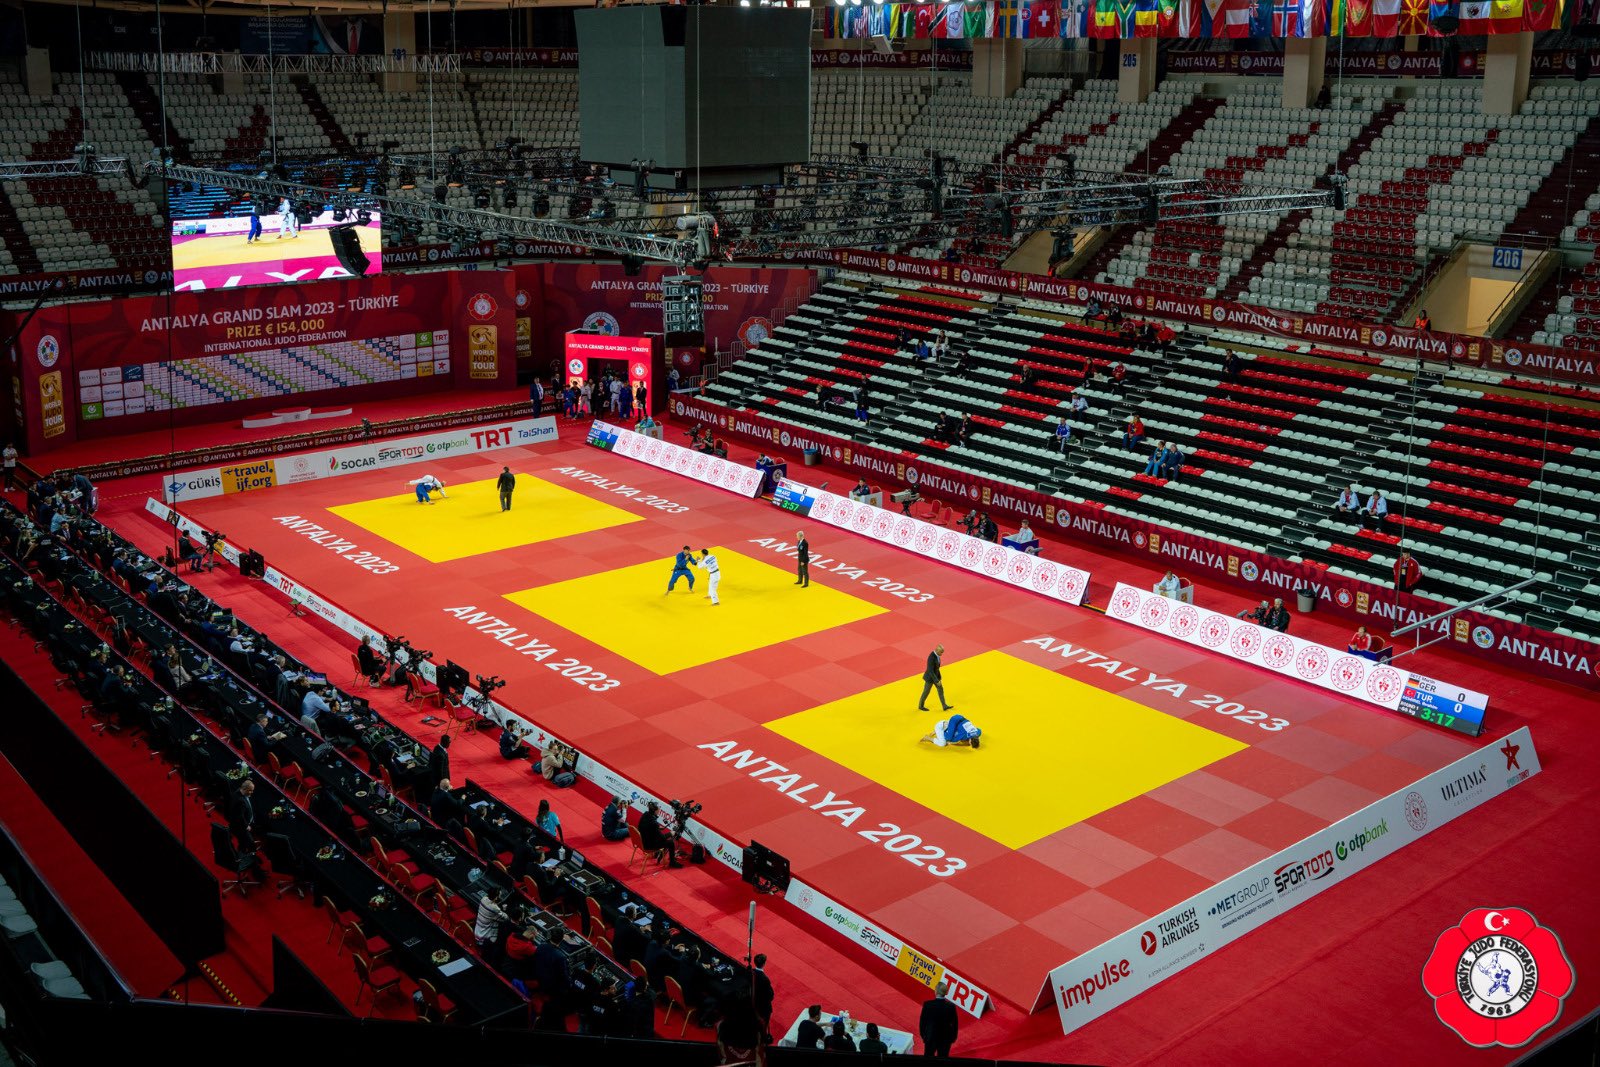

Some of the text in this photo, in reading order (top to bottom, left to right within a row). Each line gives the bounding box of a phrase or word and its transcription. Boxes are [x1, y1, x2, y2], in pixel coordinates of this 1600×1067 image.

[495, 52, 538, 61] ANTALYA
[852, 54, 960, 64] ANTALYA ANTALYA
[1123, 54, 1136, 67] 205
[1174, 58, 1216, 68] ANTALYA
[382, 252, 418, 263] NTALYA
[528, 245, 571, 255] ANTALYA
[797, 250, 834, 260] ANTALYA
[1495, 249, 1520, 268] 206
[0, 274, 132, 294] NTALYA ANTALYA
[591, 280, 634, 290] ANTALYA
[636, 281, 663, 290] GRAN
[731, 283, 768, 294] TÜRKİYE
[140, 314, 209, 332] ANTALYA
[213, 309, 262, 324] GRAND
[266, 305, 300, 320] SLAM
[305, 302, 334, 315] 2023
[349, 295, 399, 311] TÜRKİYE
[848, 254, 1594, 375] ANTALYA ANTALYA ANTALYA ANTALYA ANTALYA ANTALYA ANTALYA ANTALYA ANTALYA ANTALYA
[226, 319, 325, 338] PRIZE € 154,000
[204, 330, 346, 353] INTERNATIONAL JUDO FEDERATION
[45, 415, 63, 427] TOUR
[470, 427, 512, 449] TRT
[518, 427, 553, 438] TaiShan
[90, 470, 117, 479] ANTALYA
[132, 464, 158, 473] ANTALYA
[210, 453, 236, 461] ANTALYA
[247, 447, 272, 456] ANTALYA
[284, 441, 307, 450] ANTALYA
[320, 437, 342, 445] ANTALYA
[387, 426, 409, 435] ANTALYA
[420, 422, 442, 430] ANTALYA
[452, 417, 472, 425] ANTALYA
[482, 412, 503, 420] ANTALYA
[379, 446, 424, 460] SPORTOTO
[437, 438, 469, 451] otpbank
[235, 461, 273, 477] travel.
[341, 457, 376, 469] SOCAR
[189, 477, 221, 490] GÜRİŞ
[237, 475, 272, 491] ijf.org
[551, 466, 689, 513] ANTALYA 2023
[782, 500, 799, 511] 3:57
[272, 515, 352, 554] ANTALYA
[342, 551, 400, 574] 2023
[685, 406, 718, 425] ANTALYA
[735, 421, 772, 440] ANTALYA
[792, 437, 831, 458] ANTALYA
[852, 454, 896, 476] ANTALYA
[920, 473, 967, 496] ANTALYA
[992, 493, 1044, 518] ANTALYA
[1072, 515, 1130, 543] ANTALYA
[1161, 541, 1224, 570] ANTALYA
[1261, 568, 1332, 602] ANTALYA
[1498, 635, 1591, 675] ANTALYA
[280, 577, 294, 594] TRT
[862, 577, 935, 602] 2023
[442, 605, 621, 691] ANTALYA 2023
[1022, 636, 1290, 731] ANTALYA 2023
[1419, 682, 1465, 702] GER 0
[1416, 692, 1462, 713] TUR 0
[1421, 708, 1455, 726] 3:17
[1441, 770, 1486, 800] ULTIMA
[696, 740, 967, 877] ANTALYA 2023
[1349, 818, 1388, 852] otpbank
[1274, 850, 1334, 894] SPORTOTO
[1216, 877, 1271, 914] METGROUP
[833, 912, 860, 934] otpbank
[1158, 907, 1196, 935] TURKISH
[860, 929, 899, 958] SPORTOTO
[1161, 920, 1200, 949] AIRLINES
[909, 963, 932, 986] ijf.org
[913, 954, 936, 975] travel.
[944, 973, 984, 1012] TRT
[1060, 958, 1131, 1009] impulse
